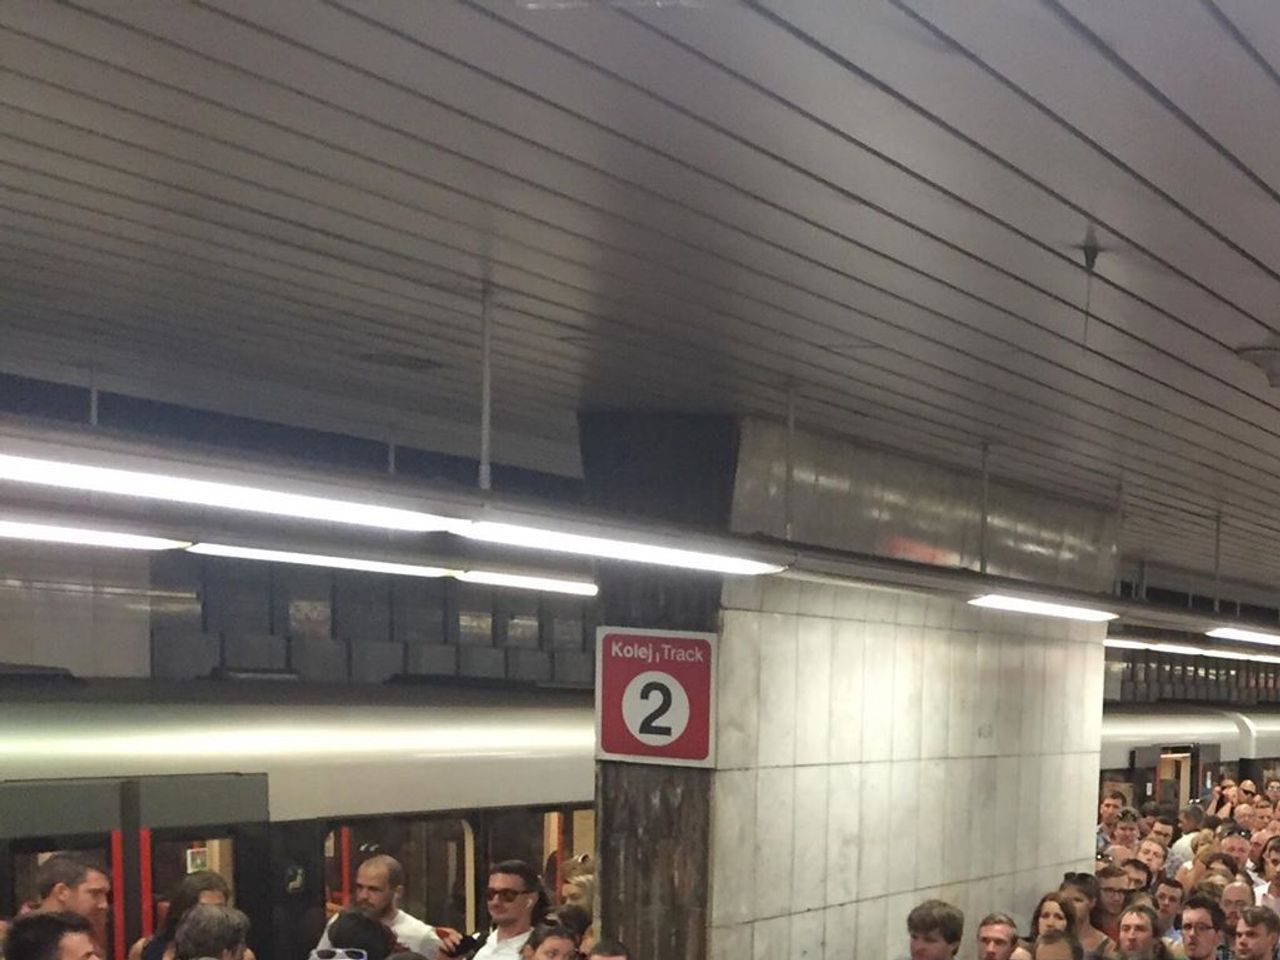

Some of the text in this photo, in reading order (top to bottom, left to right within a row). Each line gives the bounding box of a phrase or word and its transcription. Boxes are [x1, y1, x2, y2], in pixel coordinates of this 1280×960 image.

[611, 641, 704, 663] Kolej Track
[639, 681, 673, 737] 2
